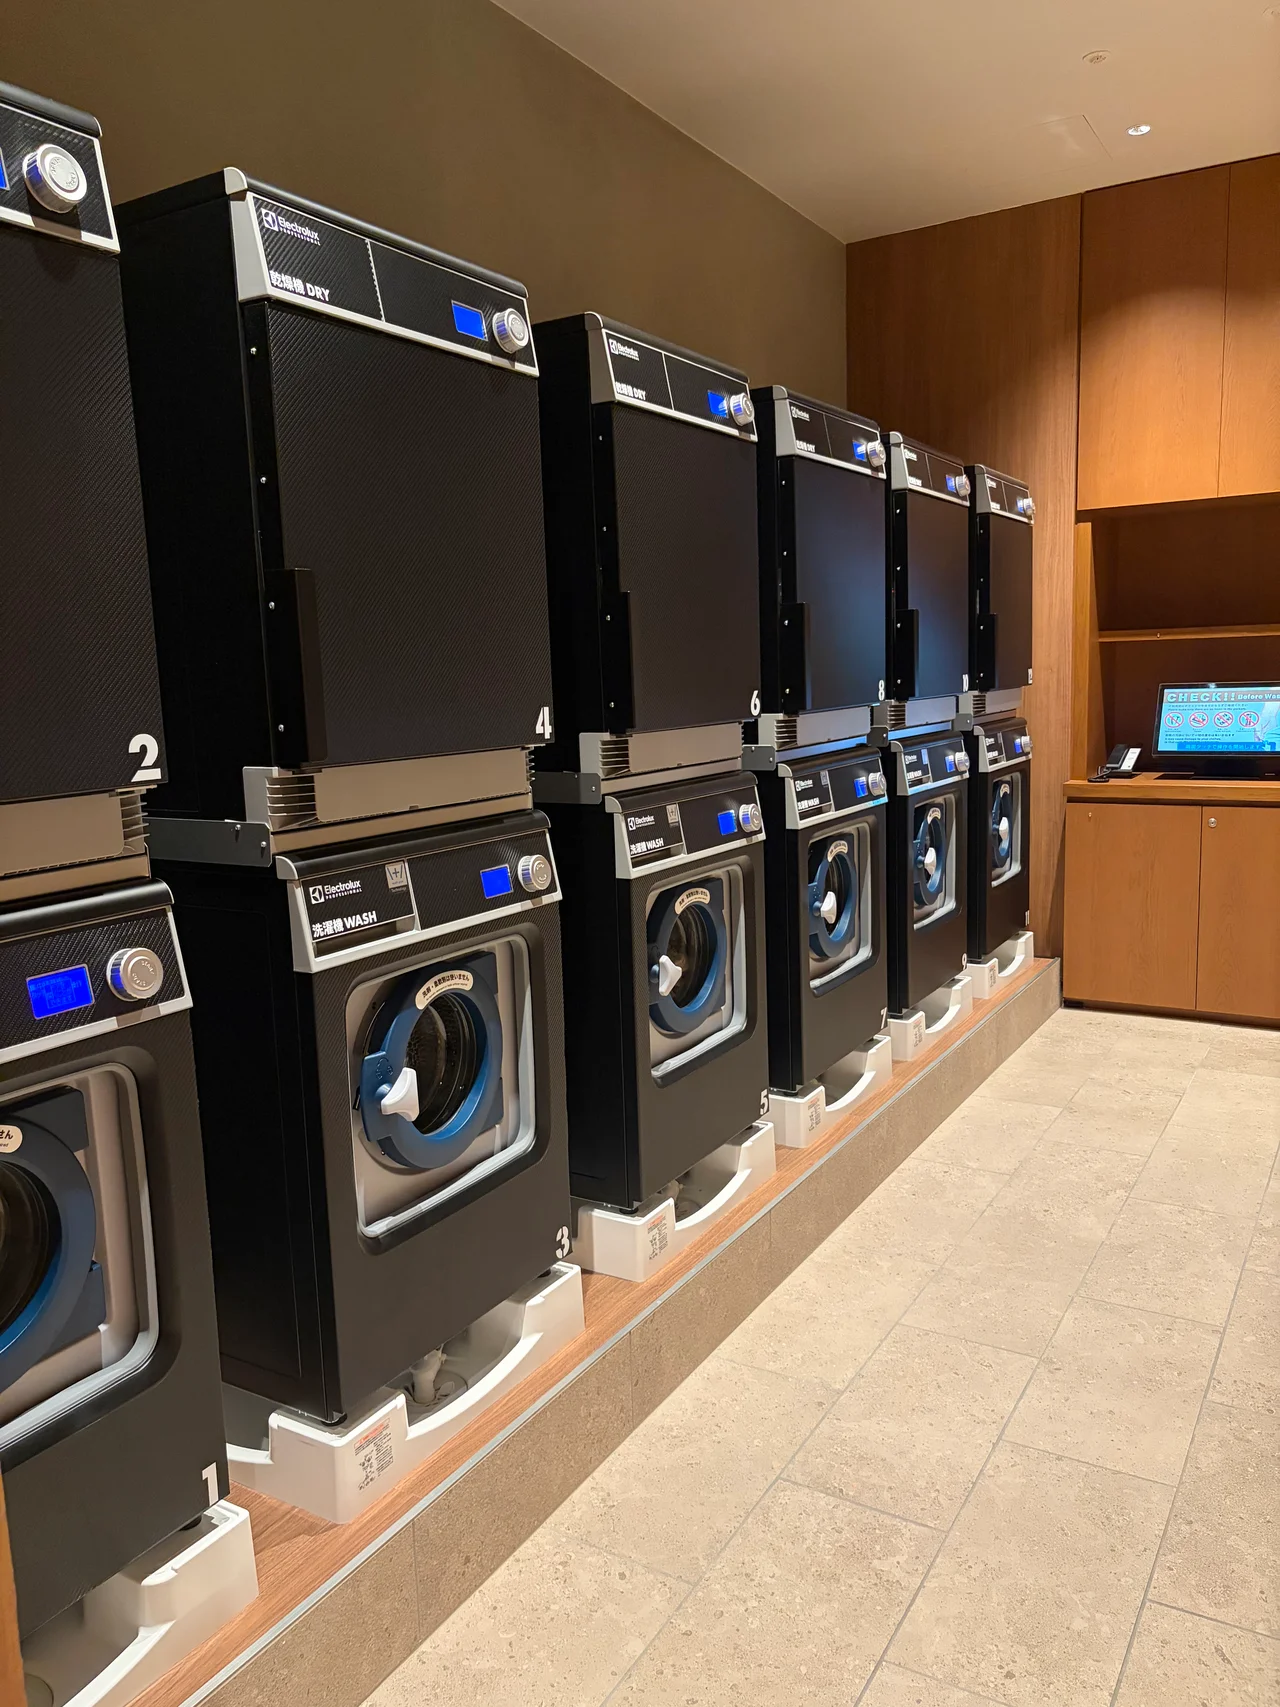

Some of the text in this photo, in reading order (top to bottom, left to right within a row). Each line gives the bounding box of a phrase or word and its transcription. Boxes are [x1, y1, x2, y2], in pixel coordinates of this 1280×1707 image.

[278, 215, 320, 240] Electrolux
[269, 270, 330, 302] 乾燥機 DRY
[878, 679, 885, 701] 8
[962, 673, 969, 693] 10
[750, 690, 761, 716] 6
[1167, 692, 1236, 703] CHECK!!
[535, 706, 552, 739] 4
[128, 733, 162, 782] 2
[646, 837, 664, 850] WASH
[324, 880, 361, 895] Electrolux
[325, 887, 362, 900] PROFESSIONAL
[312, 910, 378, 938] 洗濯機 WASH
[961, 953, 967, 971] 9
[880, 1006, 887, 1029] 7
[760, 1088, 769, 1115] 5
[555, 1225, 570, 1259] 3
[201, 1461, 219, 1507] 1
